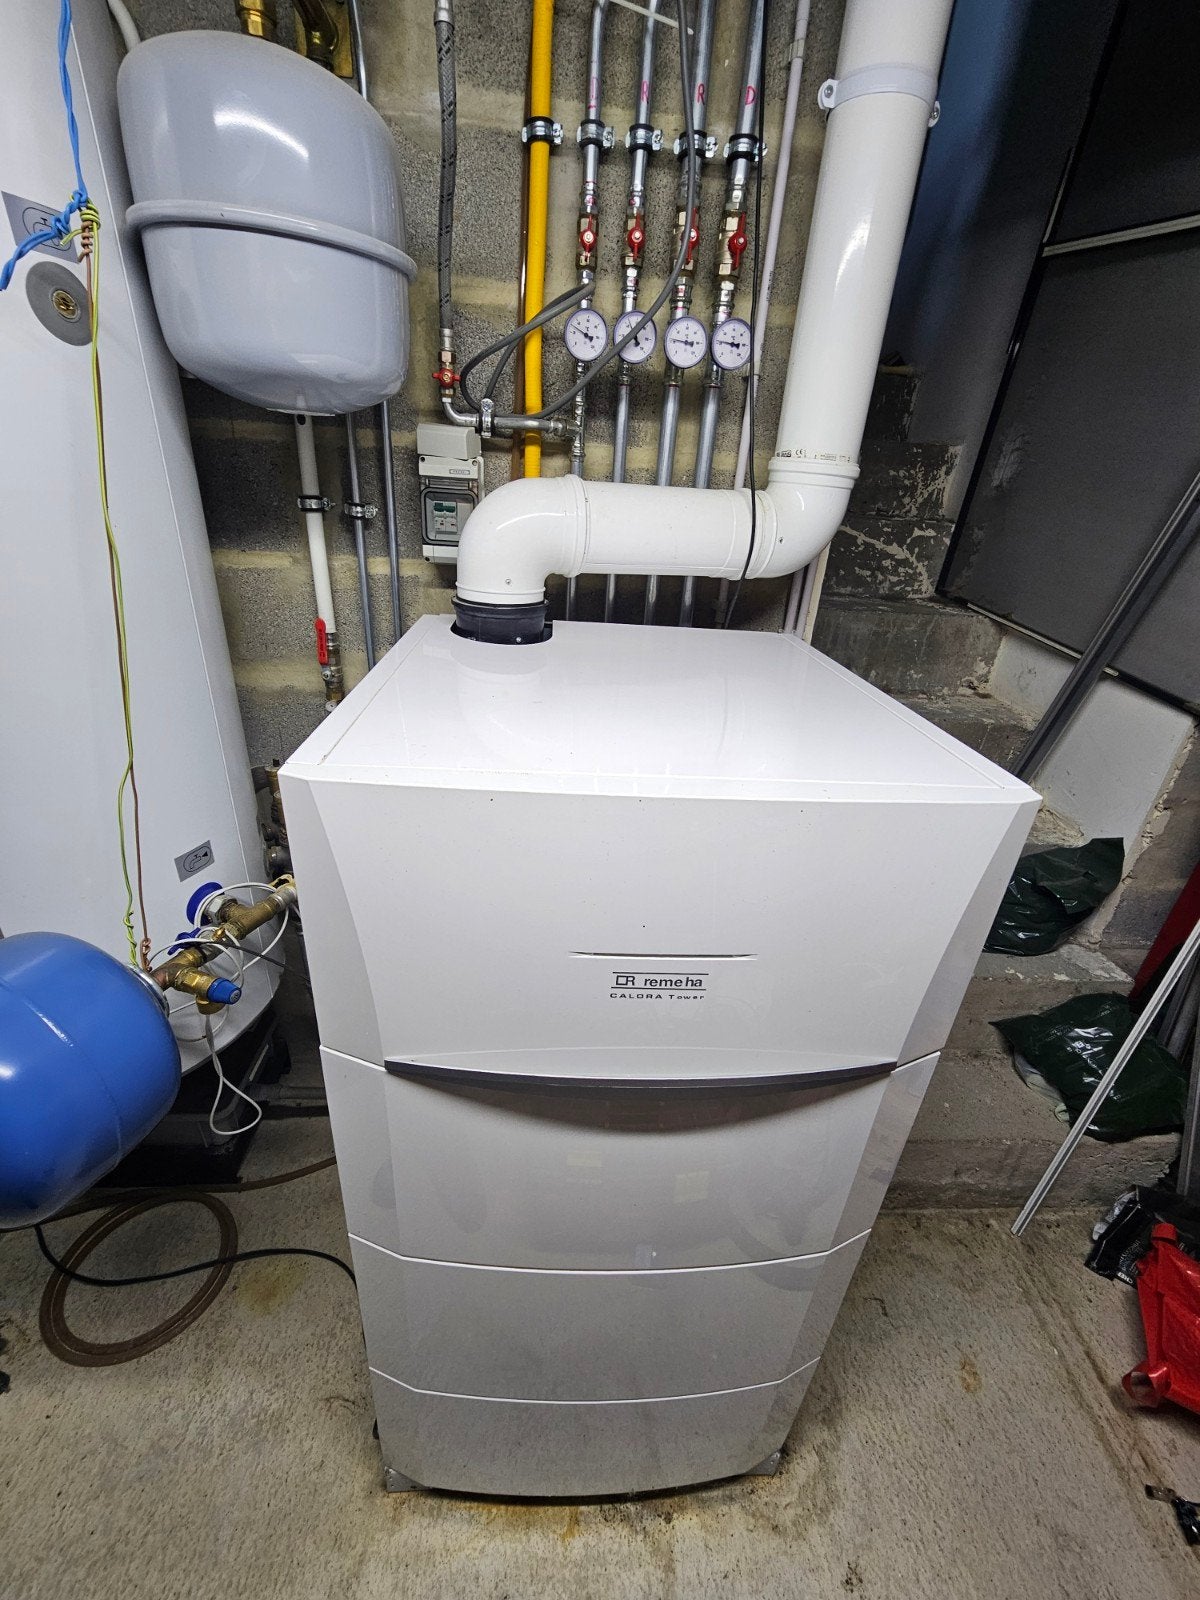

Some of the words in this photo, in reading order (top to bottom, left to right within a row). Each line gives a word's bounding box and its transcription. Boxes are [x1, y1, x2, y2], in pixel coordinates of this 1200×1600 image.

[641, 80, 649, 105] R
[697, 83, 705, 106] R
[744, 85, 756, 105] D
[644, 976, 702, 987] remeha
